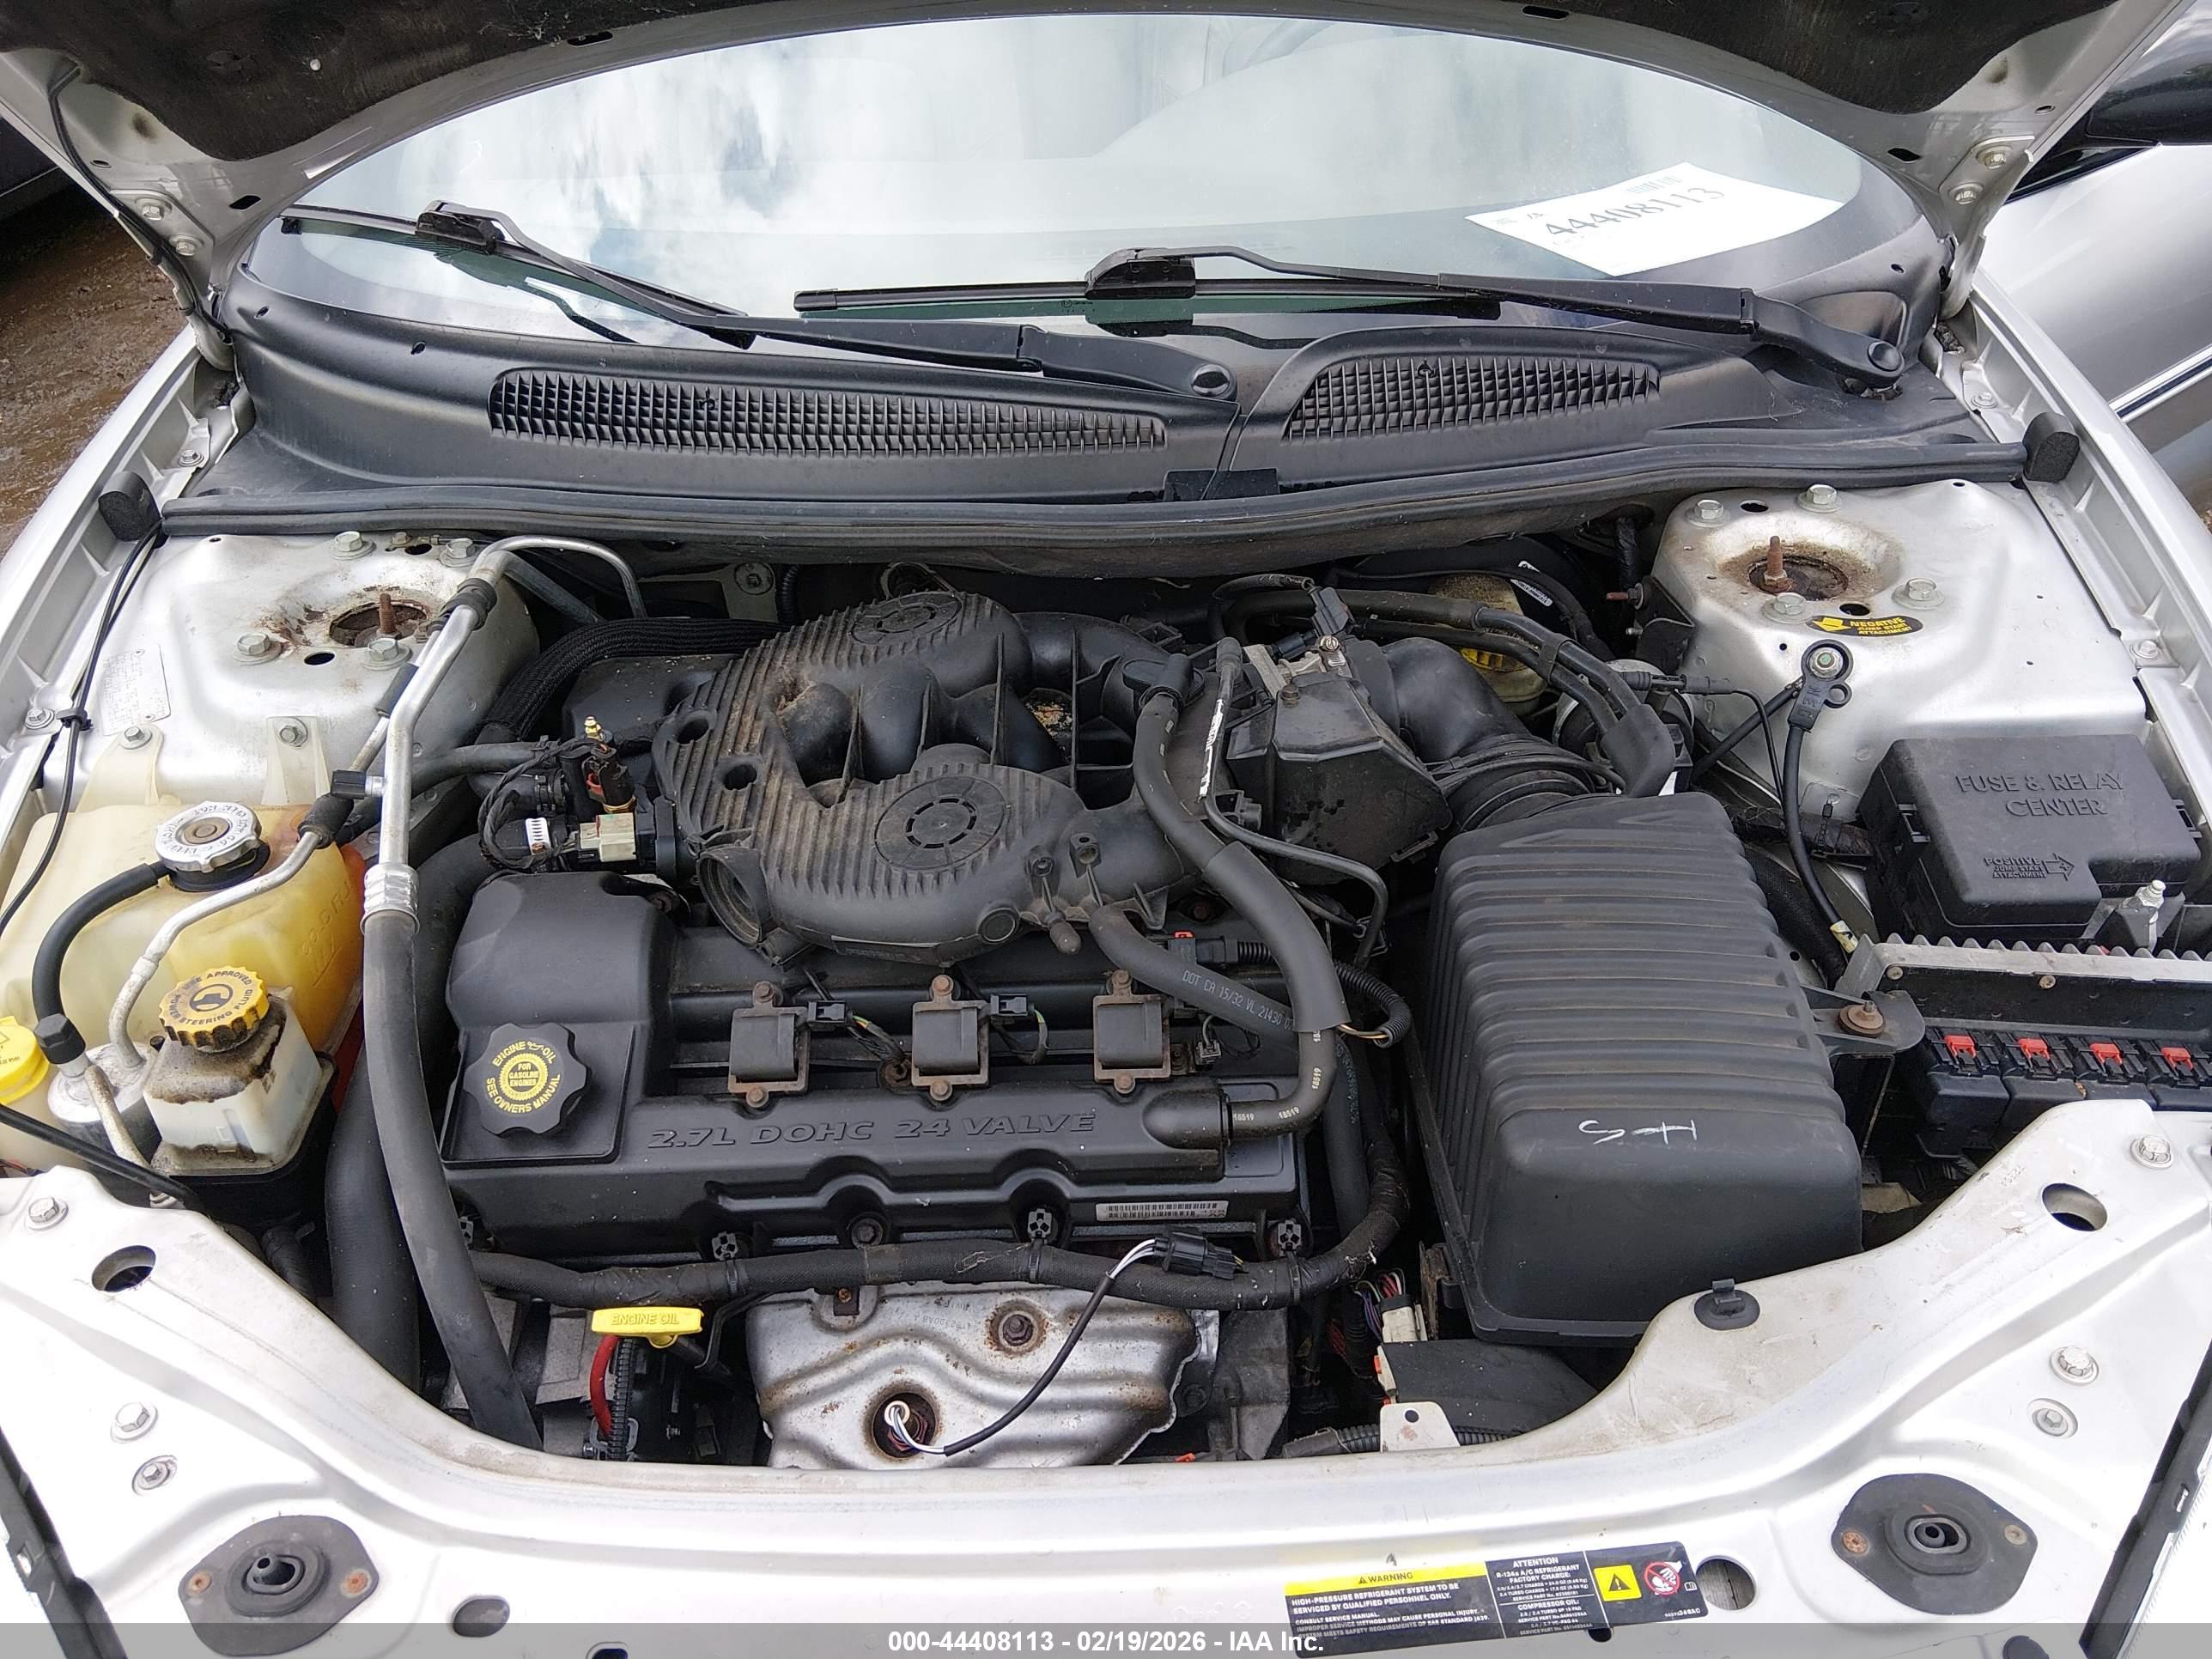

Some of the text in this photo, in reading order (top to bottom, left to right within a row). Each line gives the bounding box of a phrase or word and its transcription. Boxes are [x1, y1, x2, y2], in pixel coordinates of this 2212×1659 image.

[1546, 187, 1724, 235] 44408113
[1850, 617, 1905, 627] NEGATIVE
[1955, 773, 2123, 793] FUSE & RELAY
[2005, 798, 2108, 817] CENTER
[1984, 857, 2041, 866] POSITIVE
[206, 970, 252, 986] APPROVED
[1182, 969, 1201, 987] DOT
[168, 989, 253, 1025] POWER STEERING FLUID
[492, 1041, 556, 1066] ENGINE OIL
[508, 1071, 539, 1079] GASOLINE
[509, 1079, 537, 1087] ENGINES
[487, 1077, 499, 1098] SEE
[494, 1096, 532, 1114] OWNERS
[532, 1073, 561, 1109] MANUAL
[647, 1113, 1096, 1149] 2.7L DOHC 24 VALVE
[611, 1313, 679, 1326] ENGINE OIL
[1513, 1557, 1559, 1568] ATTENTION
[1534, 1565, 1580, 1575] REFRIGERANT
[1368, 1572, 1413, 1583] WARNING
[1510, 1575, 1540, 1583] FACTORY
[1291, 1593, 1353, 1606] HIGH-PRESSURE
[1354, 1588, 1406, 1601] REFRIGERANT
[1407, 1584, 1437, 1595] SYSTEM
[1292, 1606, 1330, 1614] SERVICED
[1342, 1600, 1382, 1610] QUALIFIED
[1384, 1595, 1430, 1605] PERSONNEL
[1517, 1601, 1565, 1610] COMPRESSOR
[1295, 1612, 1380, 1626] CONSULT SERVICE MANUAL.
[1297, 1624, 1329, 1632] IMPROPER
[1357, 1618, 1387, 1626] METHODS
[1423, 1611, 1455, 1620] PERSONAL
[1345, 1627, 1368, 1636] SAFETY
[1369, 1622, 1417, 1632] REQUIREMENTS
